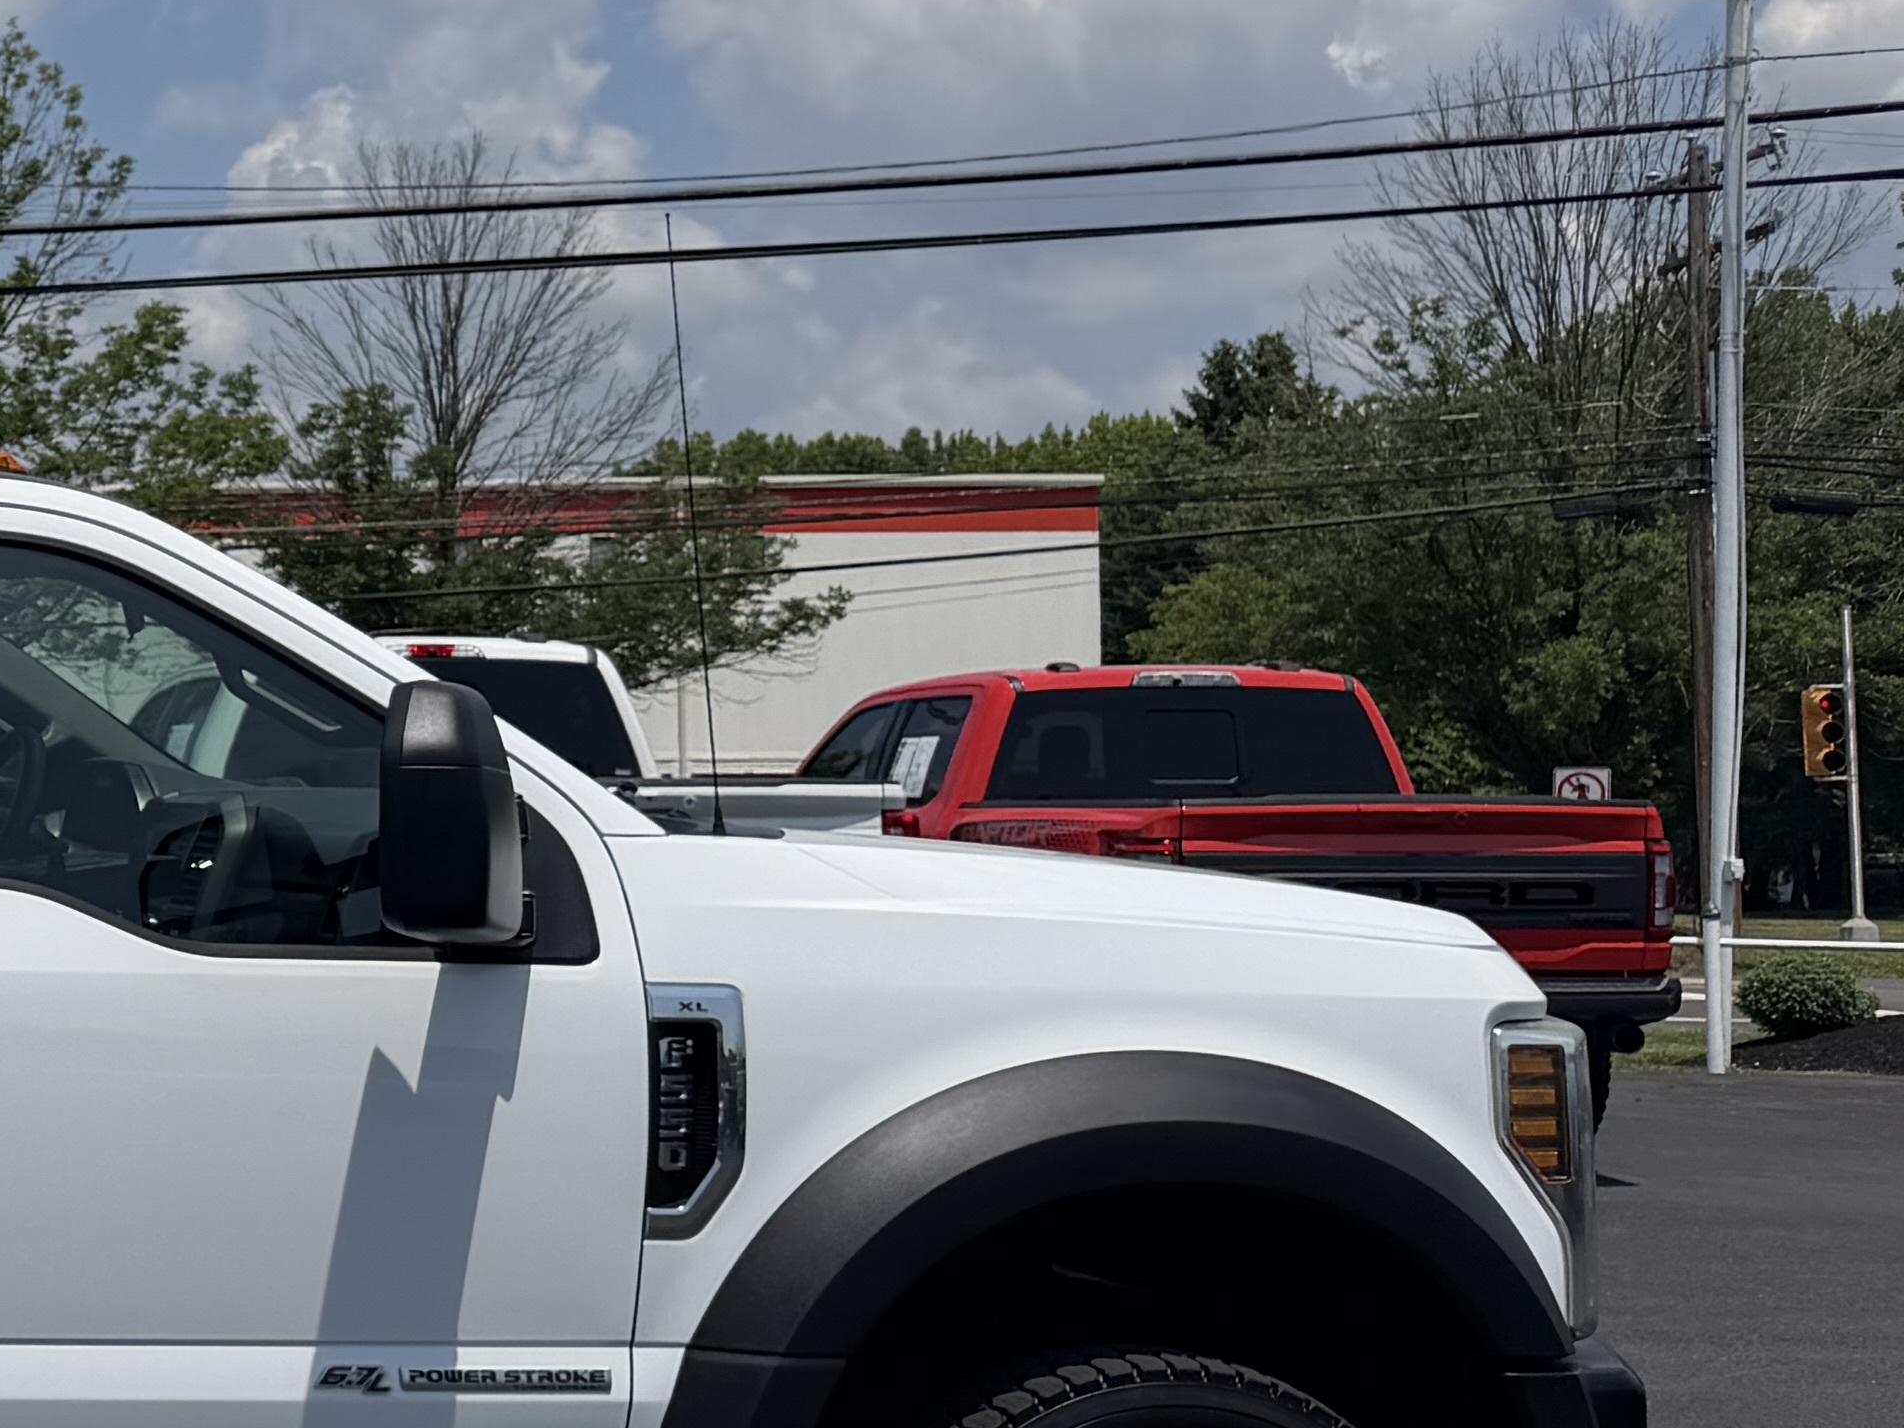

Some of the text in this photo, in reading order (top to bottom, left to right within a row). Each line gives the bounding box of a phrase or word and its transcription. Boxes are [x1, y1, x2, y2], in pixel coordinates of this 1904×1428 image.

[678, 1001, 709, 1013] XL
[318, 1366, 392, 1393] 6.7L
[408, 1369, 606, 1384] POWER STROKE
